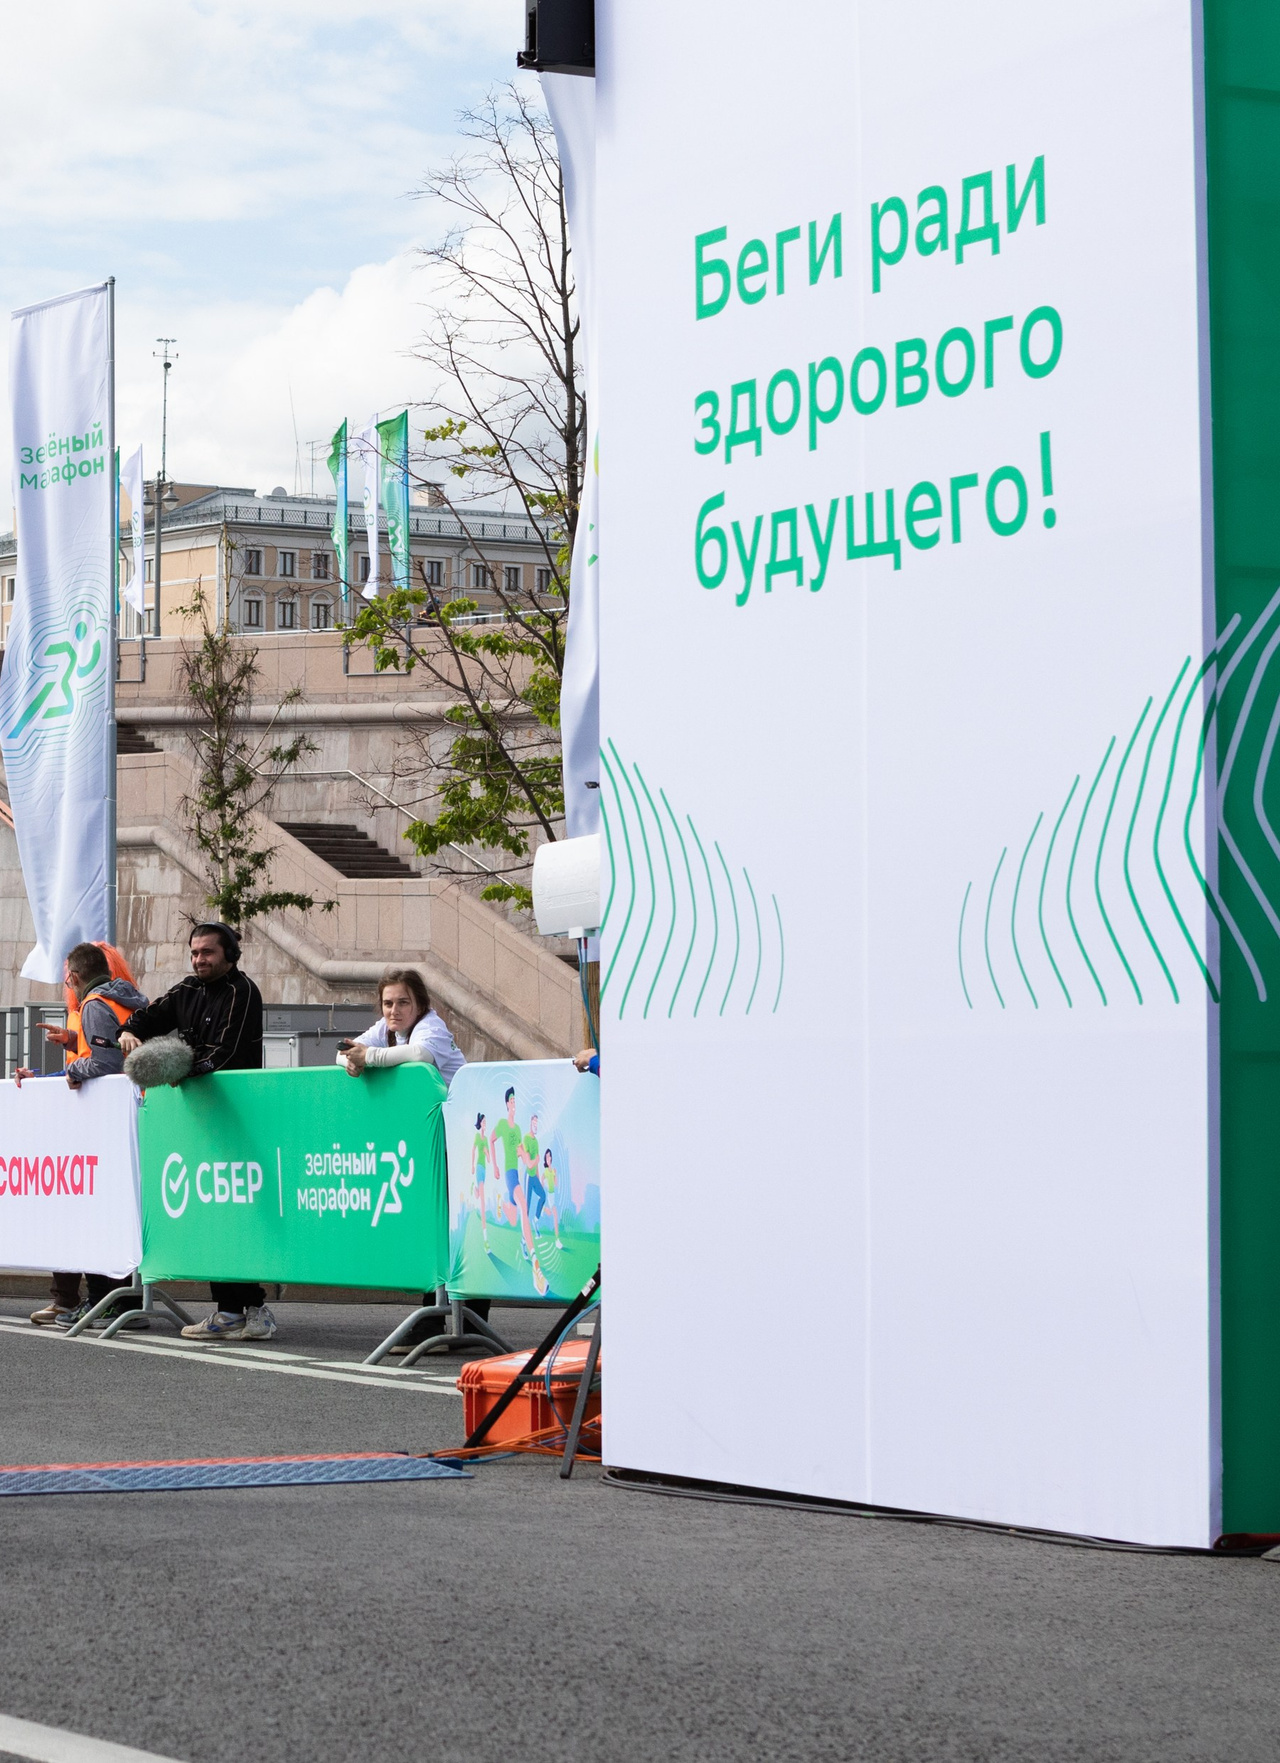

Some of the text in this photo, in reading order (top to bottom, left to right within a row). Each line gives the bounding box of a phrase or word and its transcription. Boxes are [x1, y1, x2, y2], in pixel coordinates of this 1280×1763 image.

[694, 154, 1047, 321] Беги ради
[694, 305, 1063, 465] здорового
[20, 421, 104, 465] зеёный
[694, 430, 1057, 607] будущего!
[305, 1142, 377, 1176] зелёный
[195, 1161, 263, 1204] СБЕР
[296, 1176, 371, 1219] марафон
